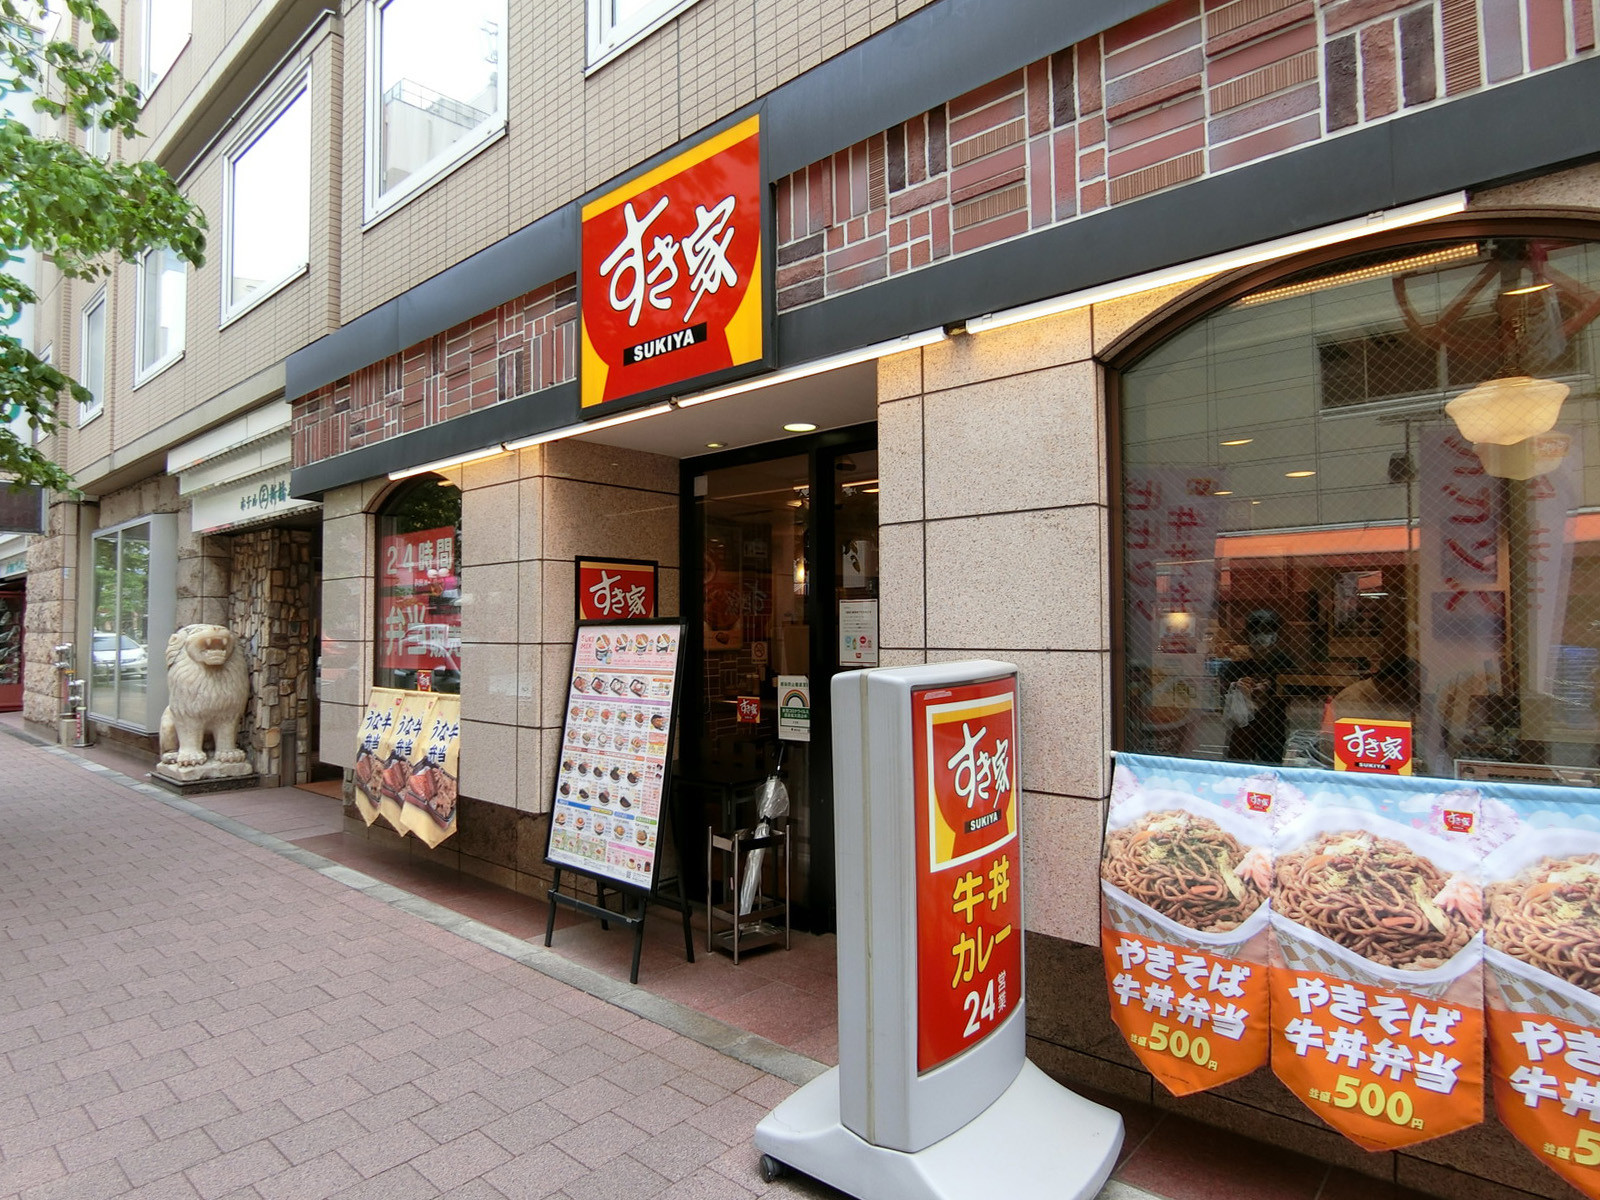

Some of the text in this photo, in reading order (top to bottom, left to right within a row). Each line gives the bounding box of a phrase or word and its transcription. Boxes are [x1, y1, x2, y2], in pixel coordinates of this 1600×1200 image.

[599, 194, 738, 327] すき家
[633, 328, 695, 362] SUKIYA
[387, 538, 452, 575] 24時間
[589, 570, 647, 619] すき家
[364, 733, 382, 751] 弁当
[366, 711, 392, 732] うな牛
[430, 719, 459, 744] うな牛
[1342, 724, 1404, 763] すき家
[395, 738, 414, 757] 弁当
[428, 744, 447, 764] 弁当
[947, 722, 1010, 809] すき家
[1358, 762, 1387, 770] SUKIYA
[970, 815, 999, 832] SUKIYA
[952, 854, 1011, 924] 牛丼
[951, 924, 1012, 989] カレー
[1114, 936, 1252, 999] やきそば
[962, 978, 996, 1039] 24
[1111, 971, 1250, 1041] 牛丼弁当
[1287, 976, 1463, 1046] やきそば
[1284, 1016, 1462, 1095] 牛丼弁当
